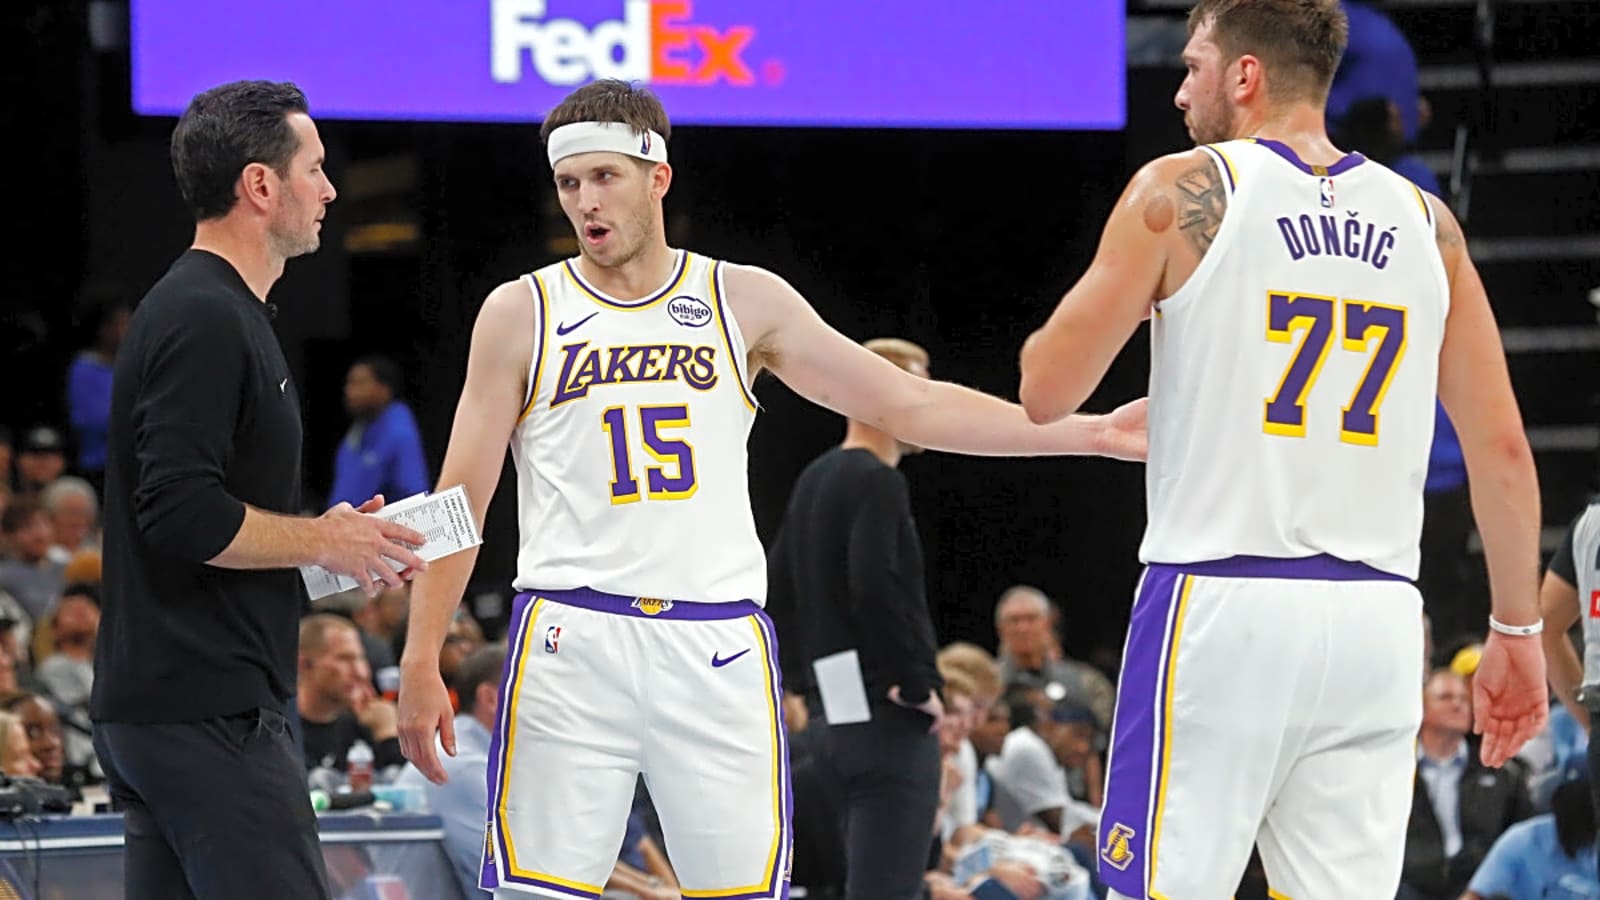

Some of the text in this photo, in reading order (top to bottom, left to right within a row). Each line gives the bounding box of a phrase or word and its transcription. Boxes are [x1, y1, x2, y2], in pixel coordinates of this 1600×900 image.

[490, 0, 756, 85] FedEx
[1276, 210, 1397, 270] DONČIĆ
[671, 303, 709, 319] bibigo
[549, 340, 718, 409] LAKERS
[1262, 289, 1408, 447] 77
[601, 403, 698, 505] 15
